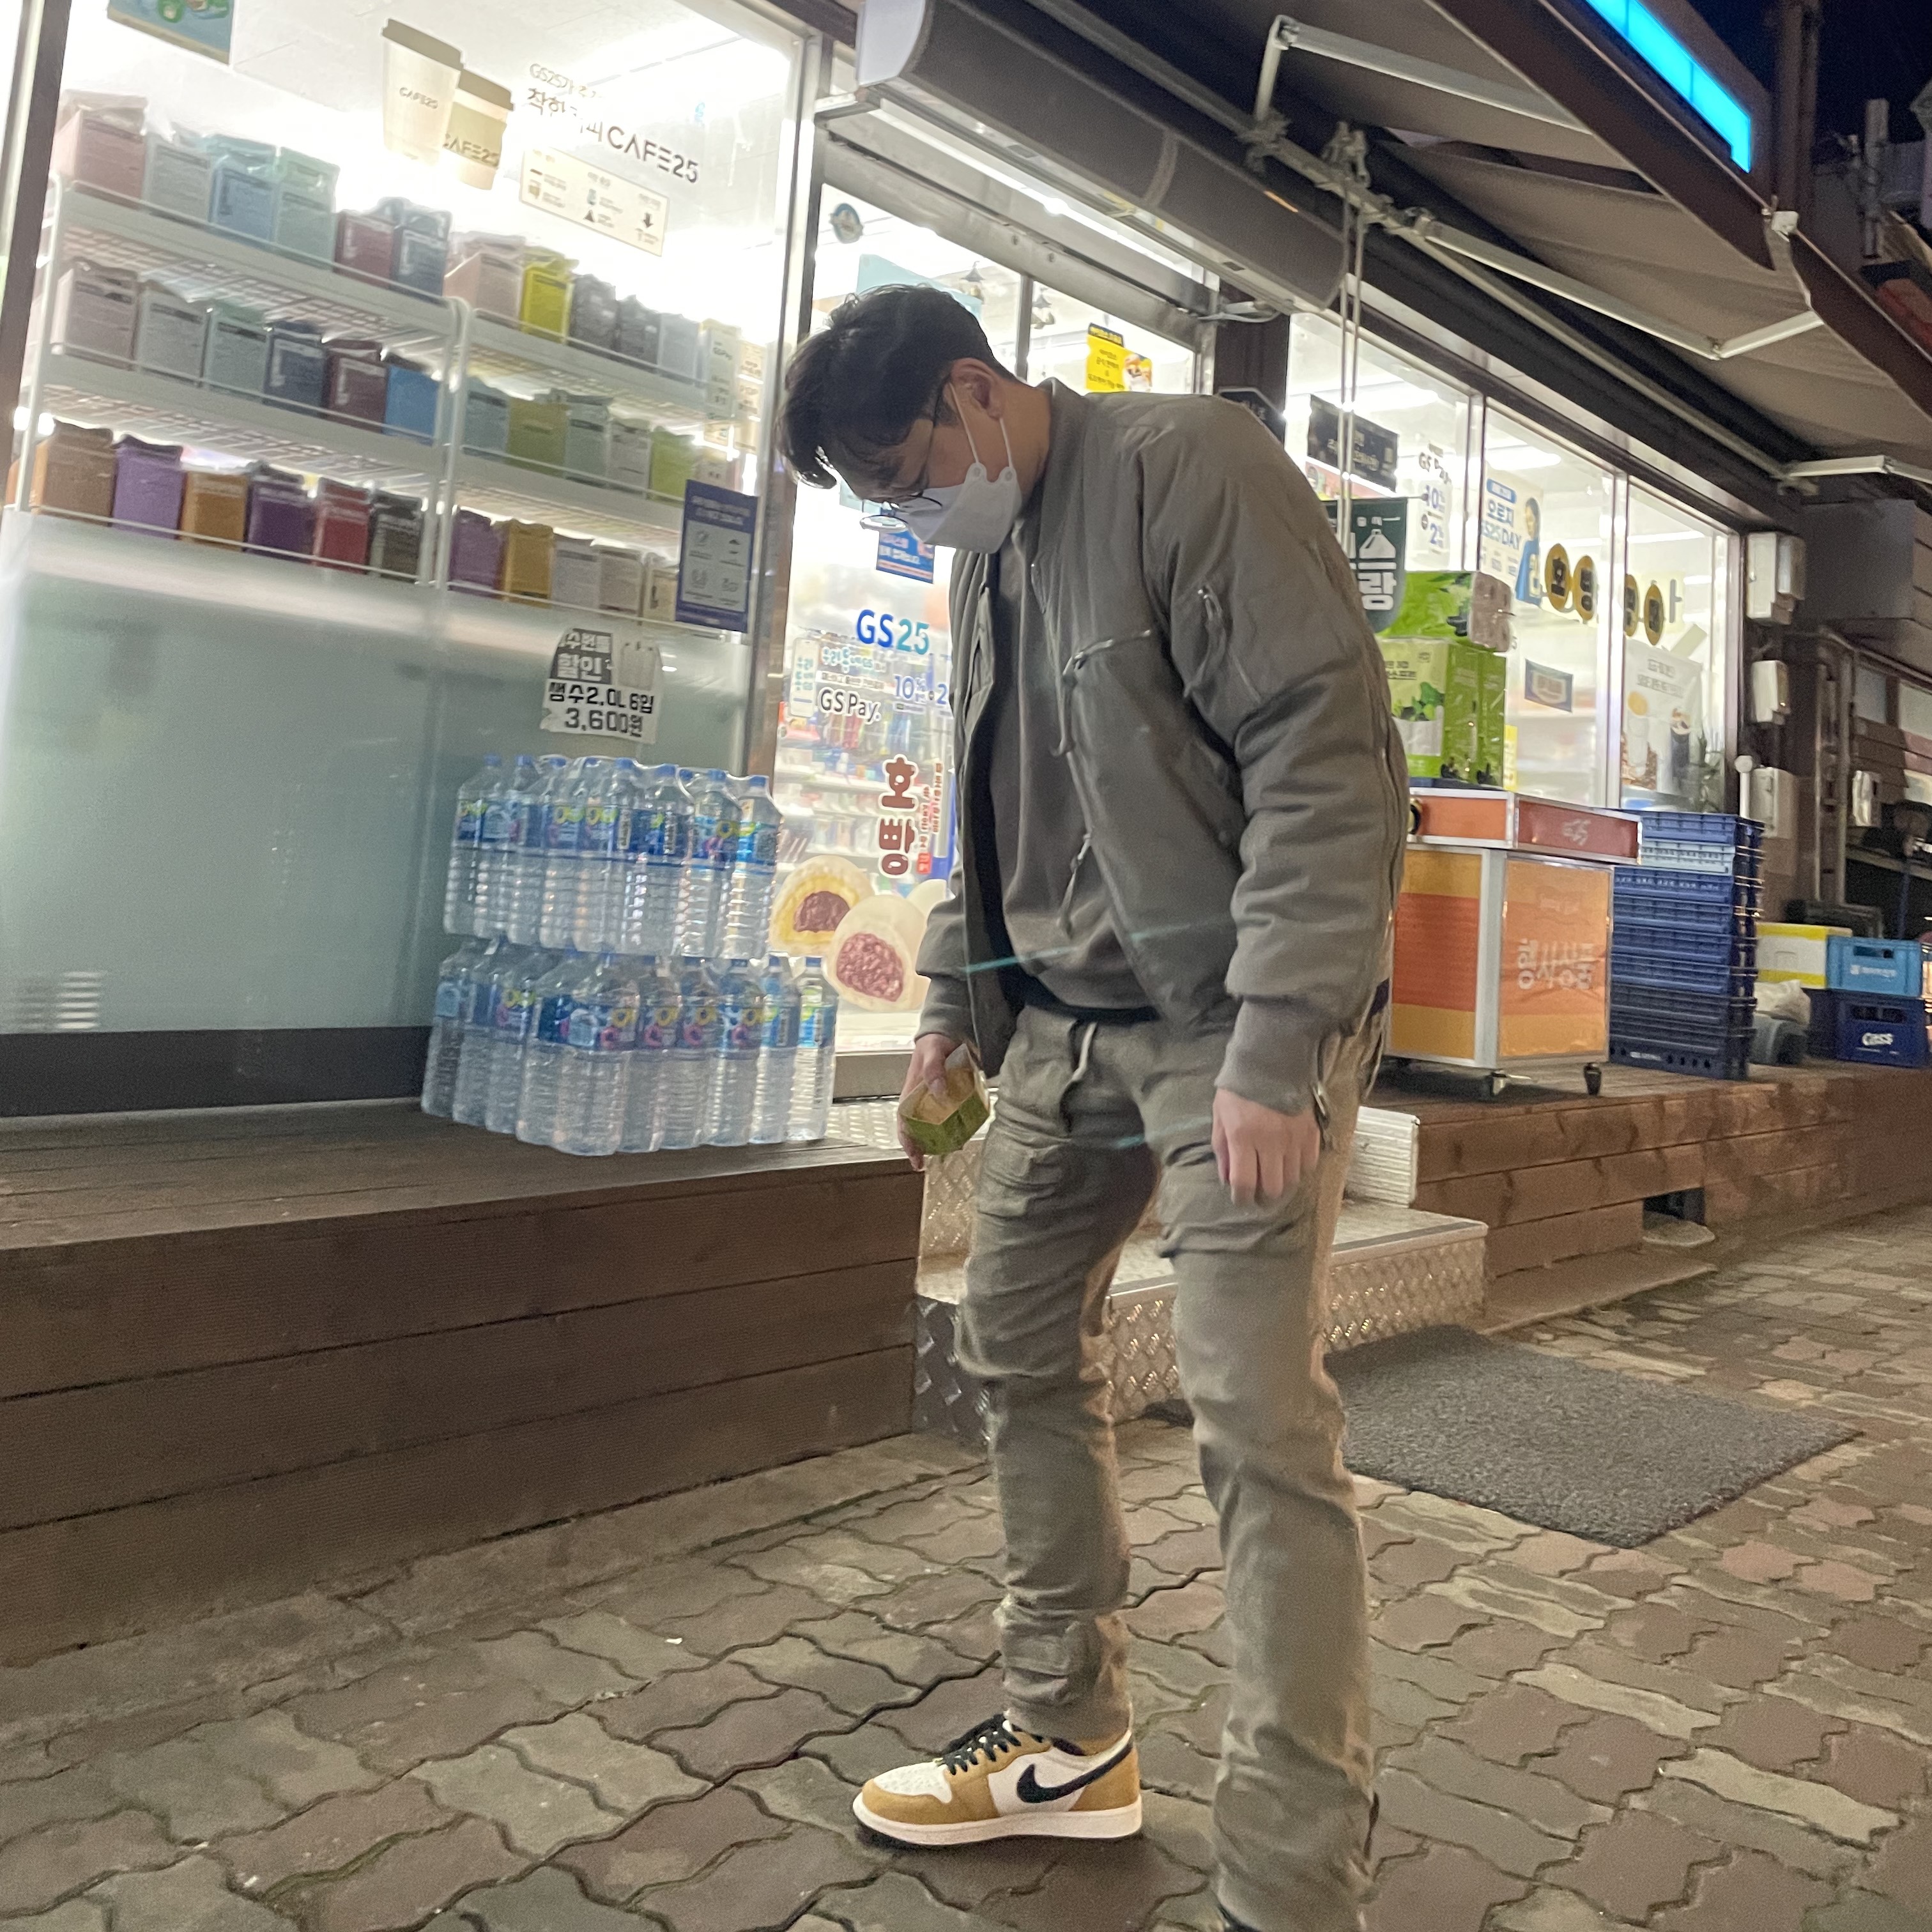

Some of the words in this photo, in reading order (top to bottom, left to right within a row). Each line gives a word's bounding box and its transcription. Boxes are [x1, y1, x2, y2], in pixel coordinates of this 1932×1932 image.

[607, 126, 700, 183] CAFE25
[857, 609, 930, 656] GS25
[556, 654, 602, 682] 할인
[879, 756, 916, 875] 호빵
